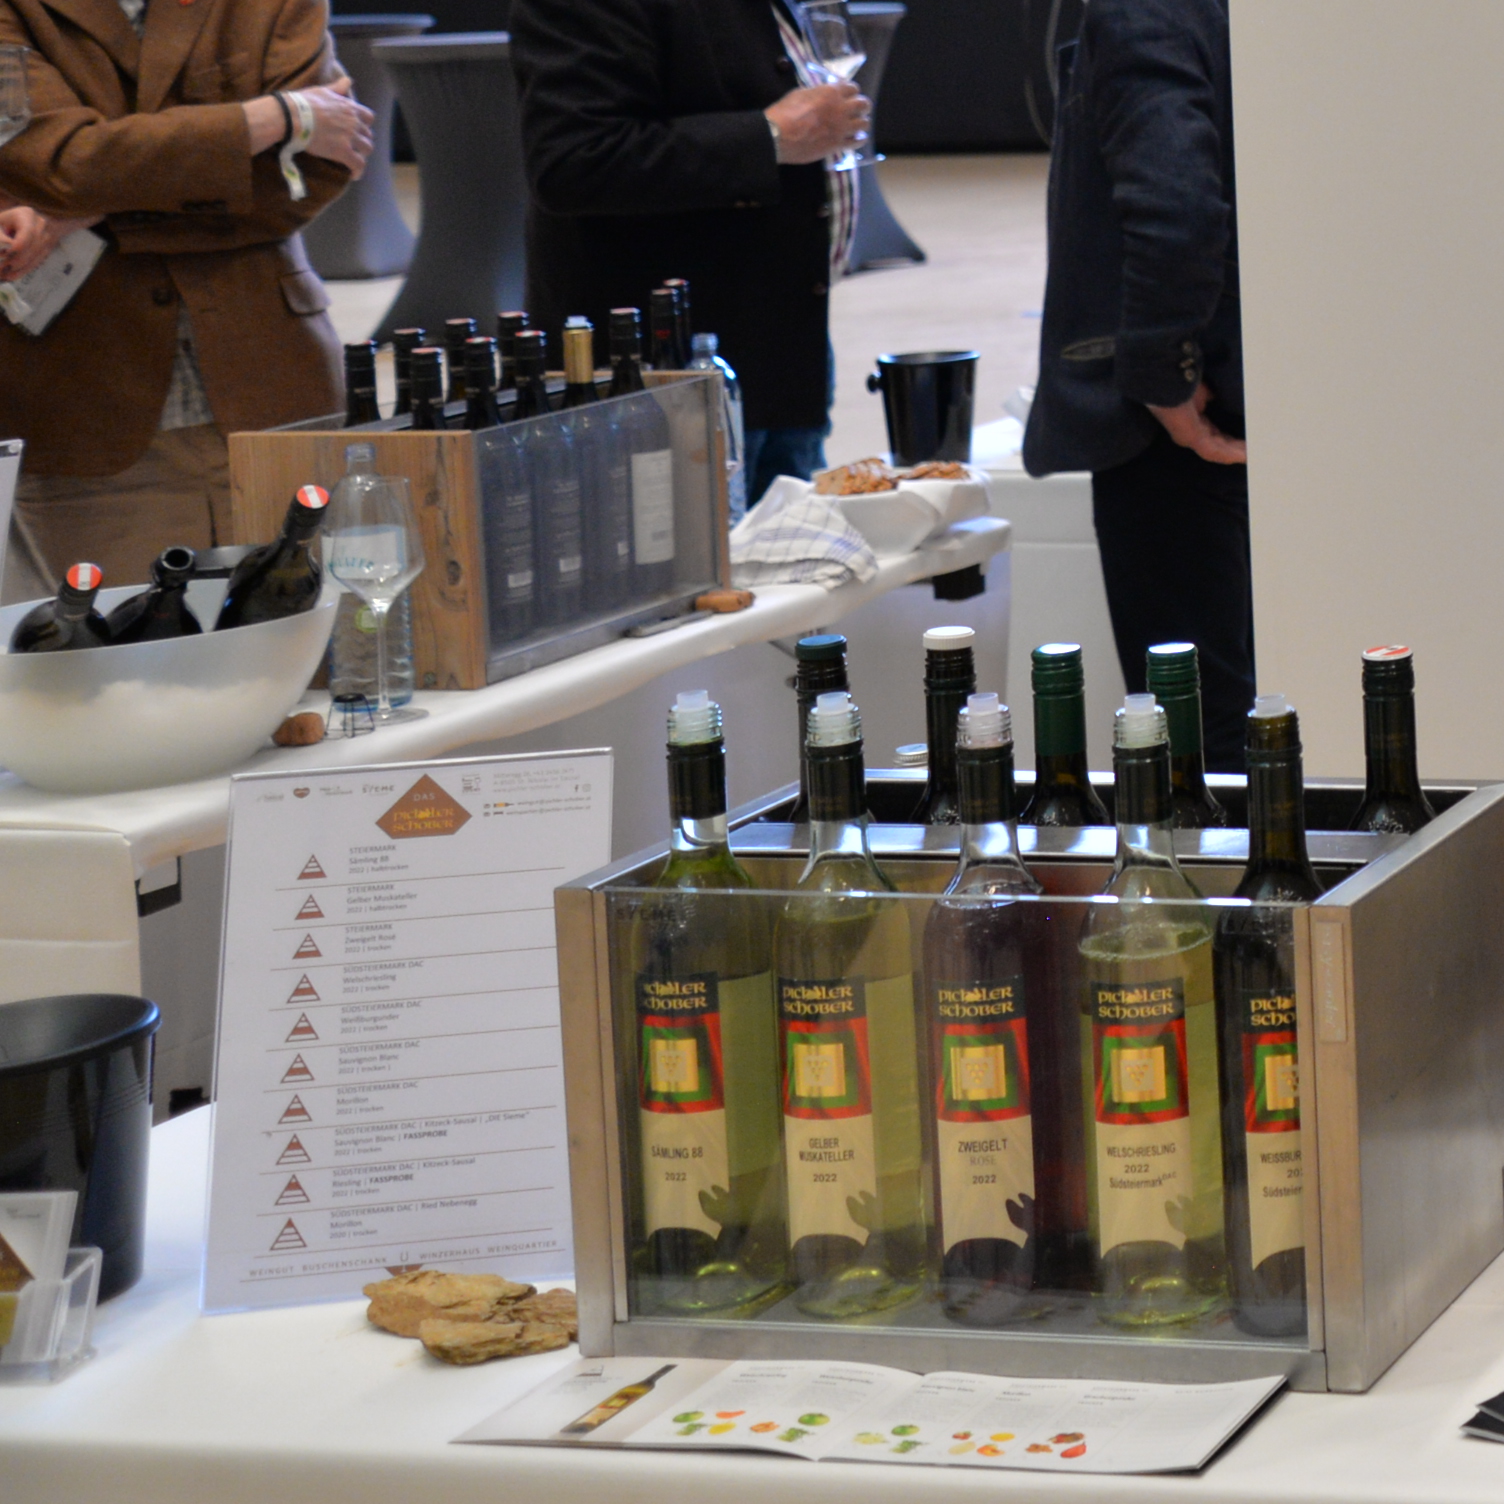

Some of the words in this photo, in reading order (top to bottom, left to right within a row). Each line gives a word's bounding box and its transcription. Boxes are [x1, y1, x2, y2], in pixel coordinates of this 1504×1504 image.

[403, 1129, 448, 1140] FASSPROBE
[809, 1138, 840, 1149] GELBER
[957, 1139, 1008, 1152] ZWEIGELT
[692, 1145, 704, 1159] 88
[798, 1149, 855, 1163] MUSKATELLER
[1106, 1143, 1176, 1158] WELSCHRIESLING
[1124, 1163, 1150, 1174] 2022
[369, 1173, 414, 1184] FASSPROBE
[664, 1172, 687, 1182] 2022
[813, 1173, 837, 1183] 2022
[972, 1174, 997, 1185] 2022
